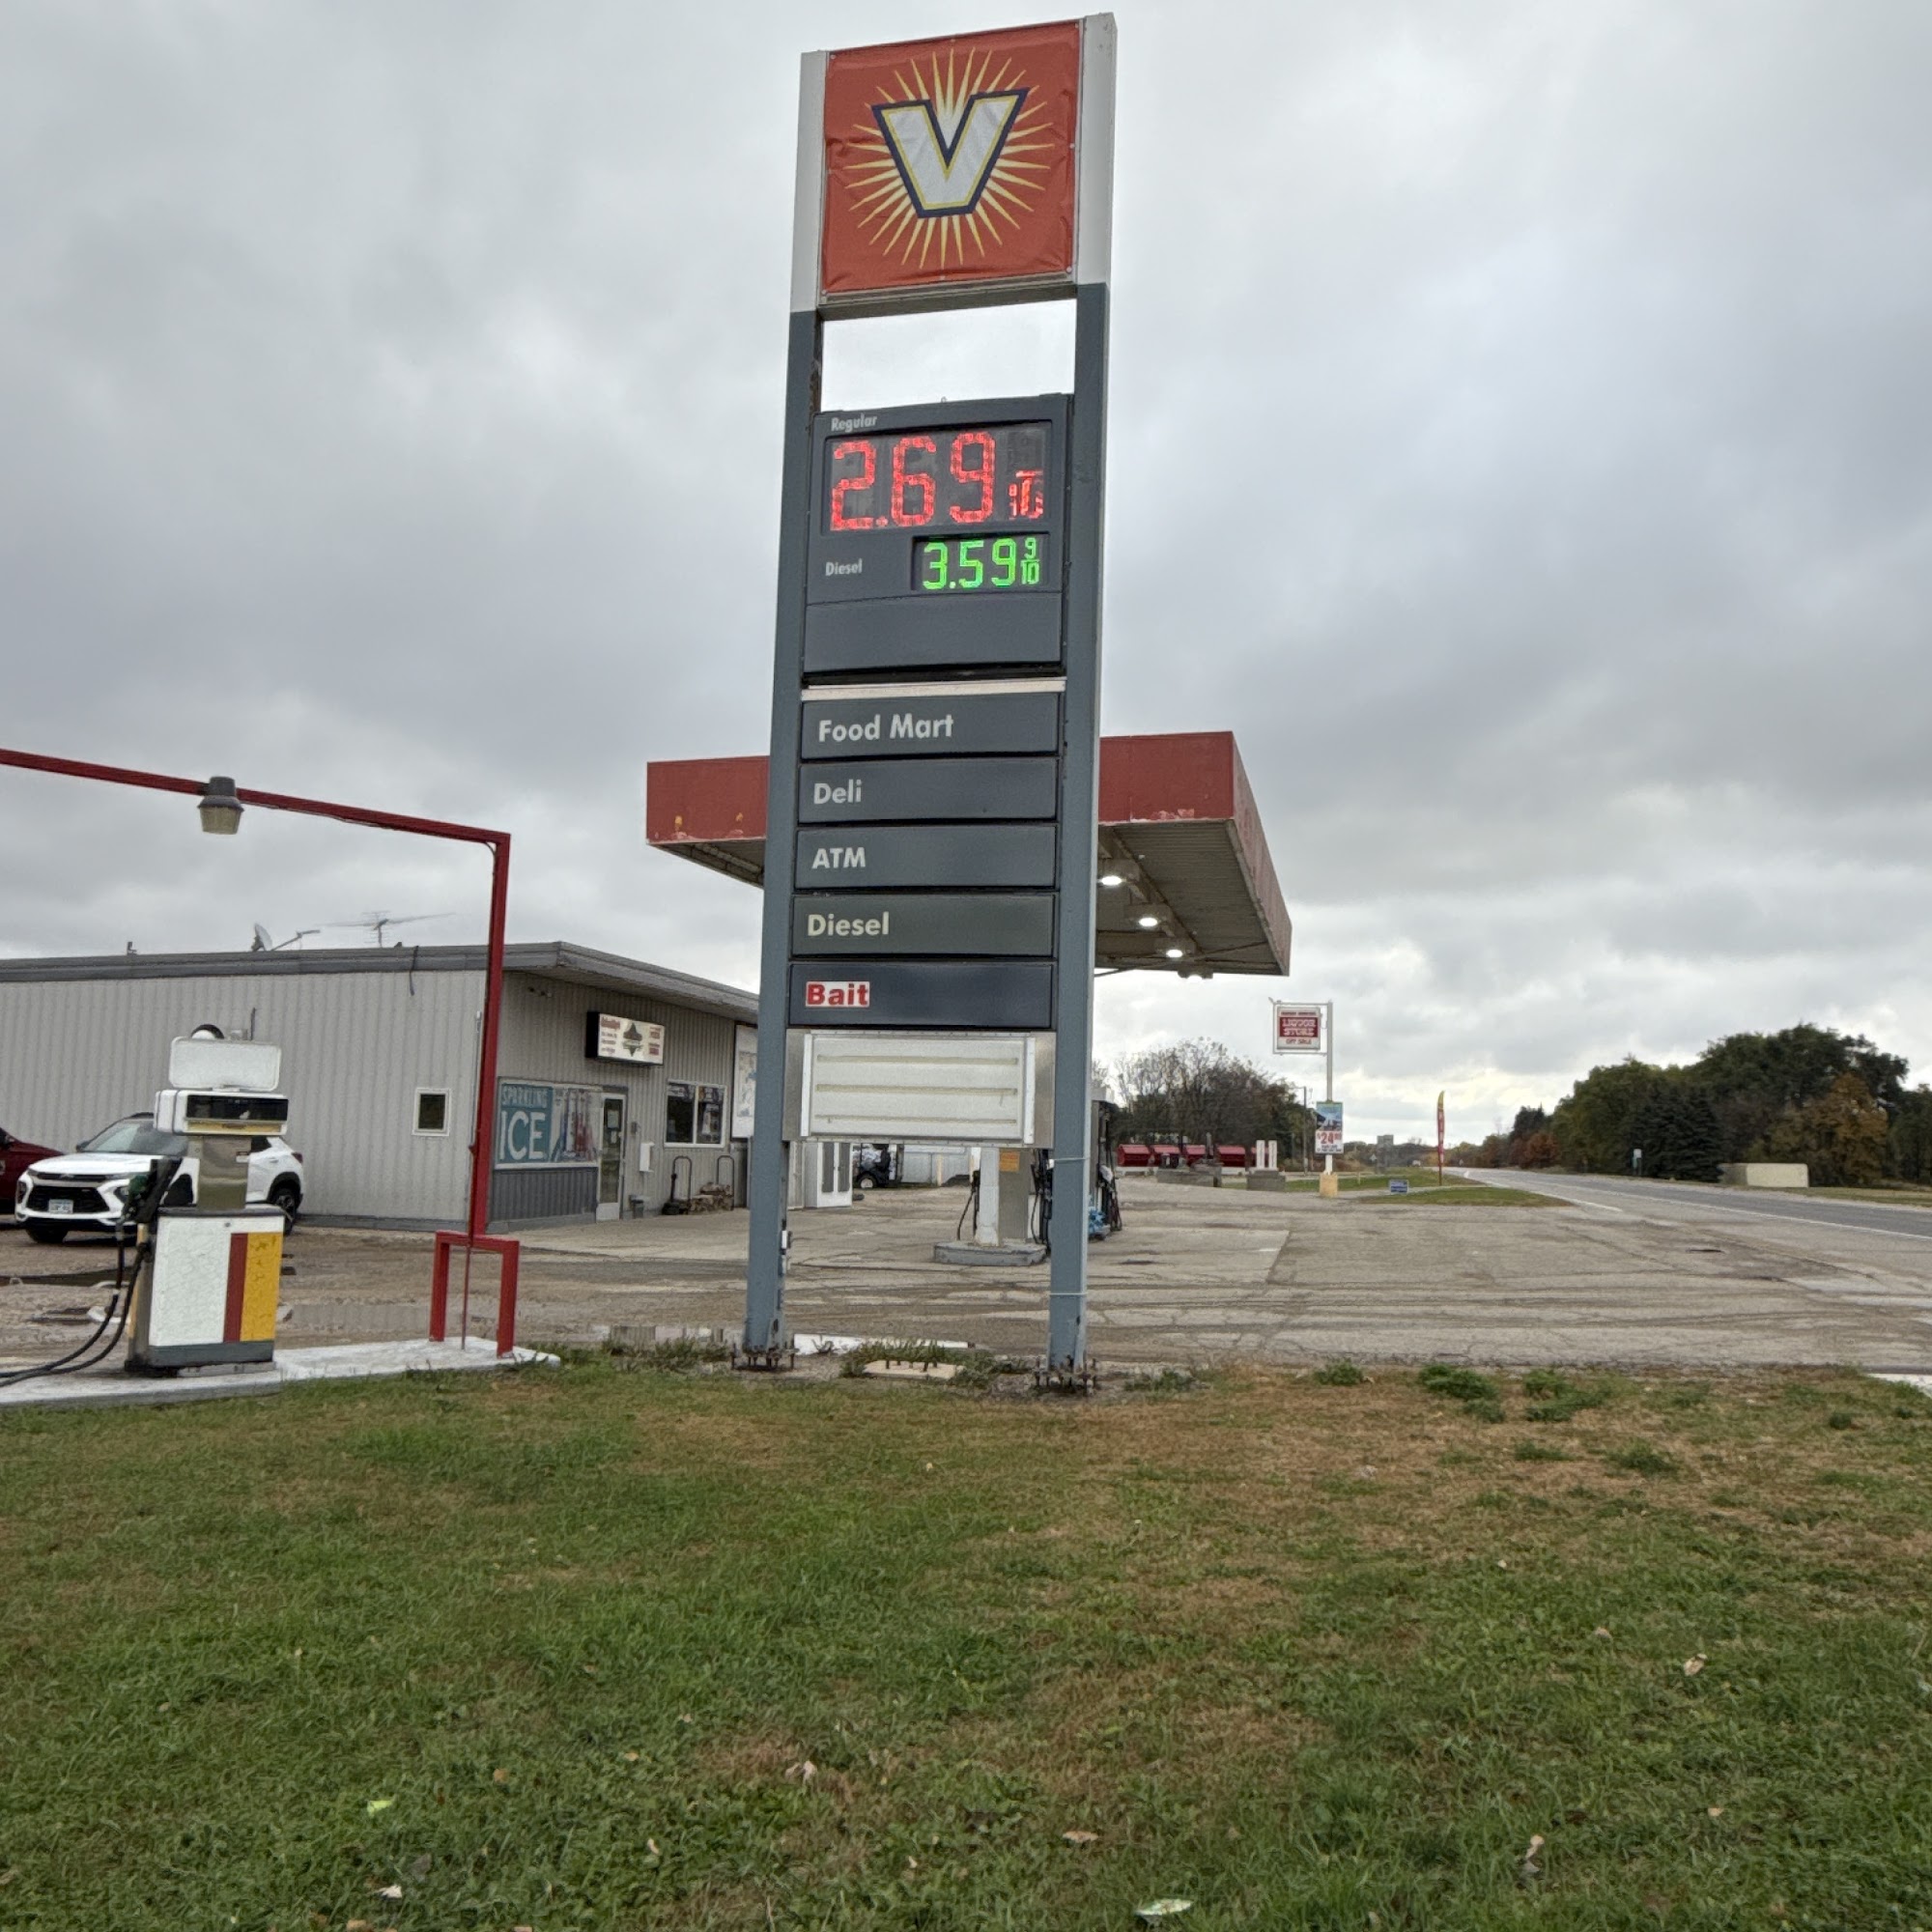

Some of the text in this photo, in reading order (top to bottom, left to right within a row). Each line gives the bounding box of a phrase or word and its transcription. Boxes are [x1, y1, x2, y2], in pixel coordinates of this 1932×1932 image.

[871, 87, 1031, 218] V
[831, 414, 877, 432] Regular
[825, 559, 863, 577] Diesel
[818, 713, 954, 742] Food Mart
[812, 779, 862, 805] Deli
[811, 846, 867, 869] ATM
[807, 911, 890, 936] Diesel
[806, 982, 869, 1006] Bait
[499, 1111, 547, 1160] ICE
